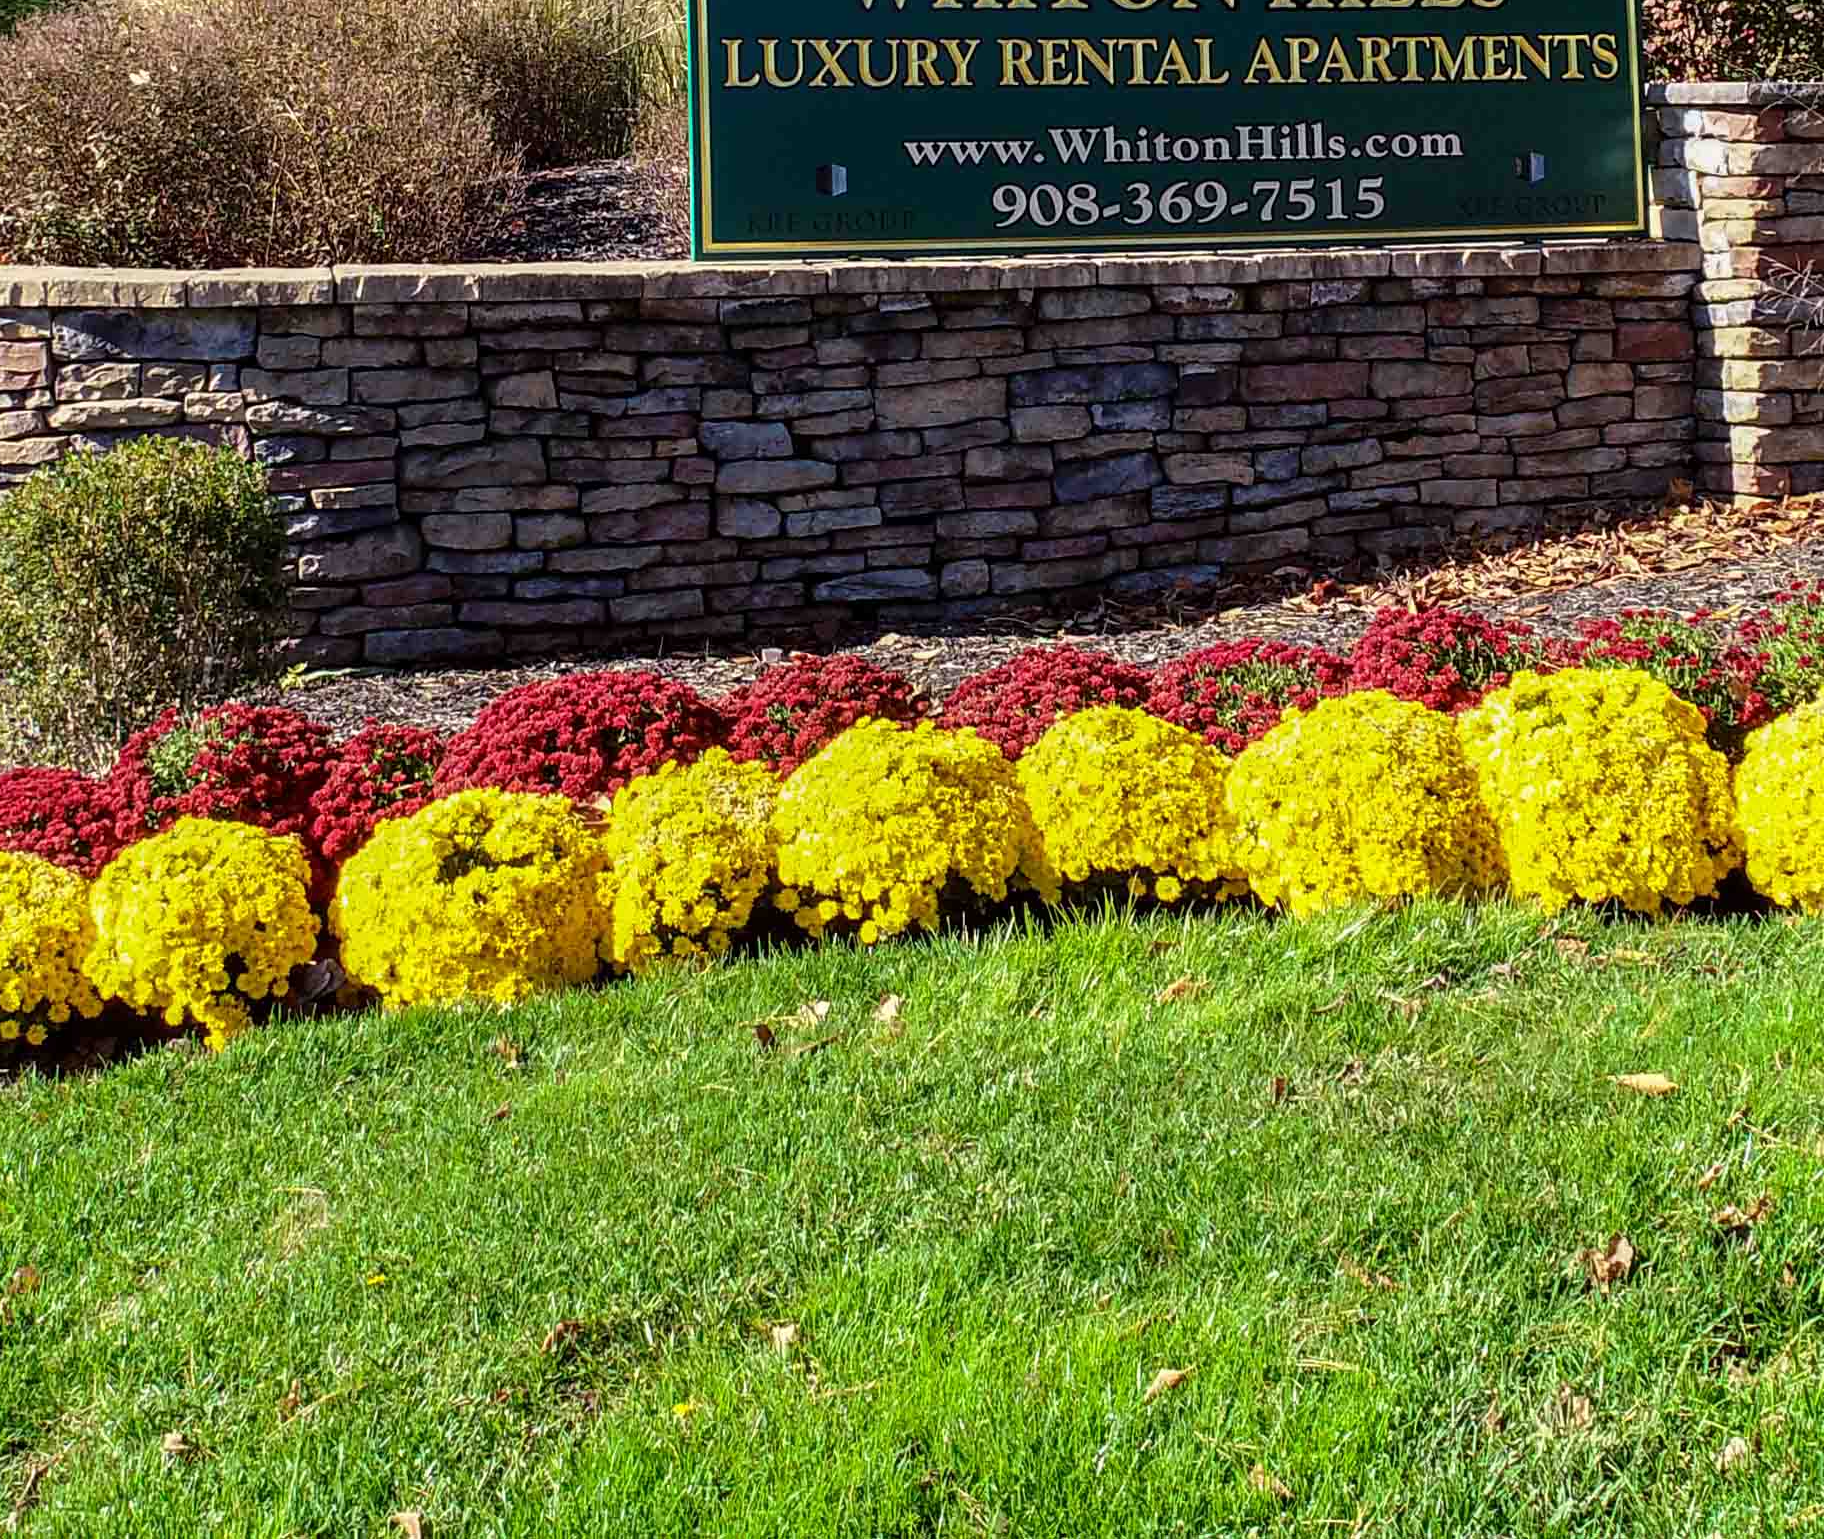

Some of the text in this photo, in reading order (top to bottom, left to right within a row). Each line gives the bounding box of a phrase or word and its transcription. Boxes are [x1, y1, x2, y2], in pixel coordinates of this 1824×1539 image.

[722, 34, 1619, 88] LUXURY RENTAL APARTMENTS
[904, 123, 1464, 166] www.WhitonHills.com
[992, 177, 1386, 228] 908-369-7515
